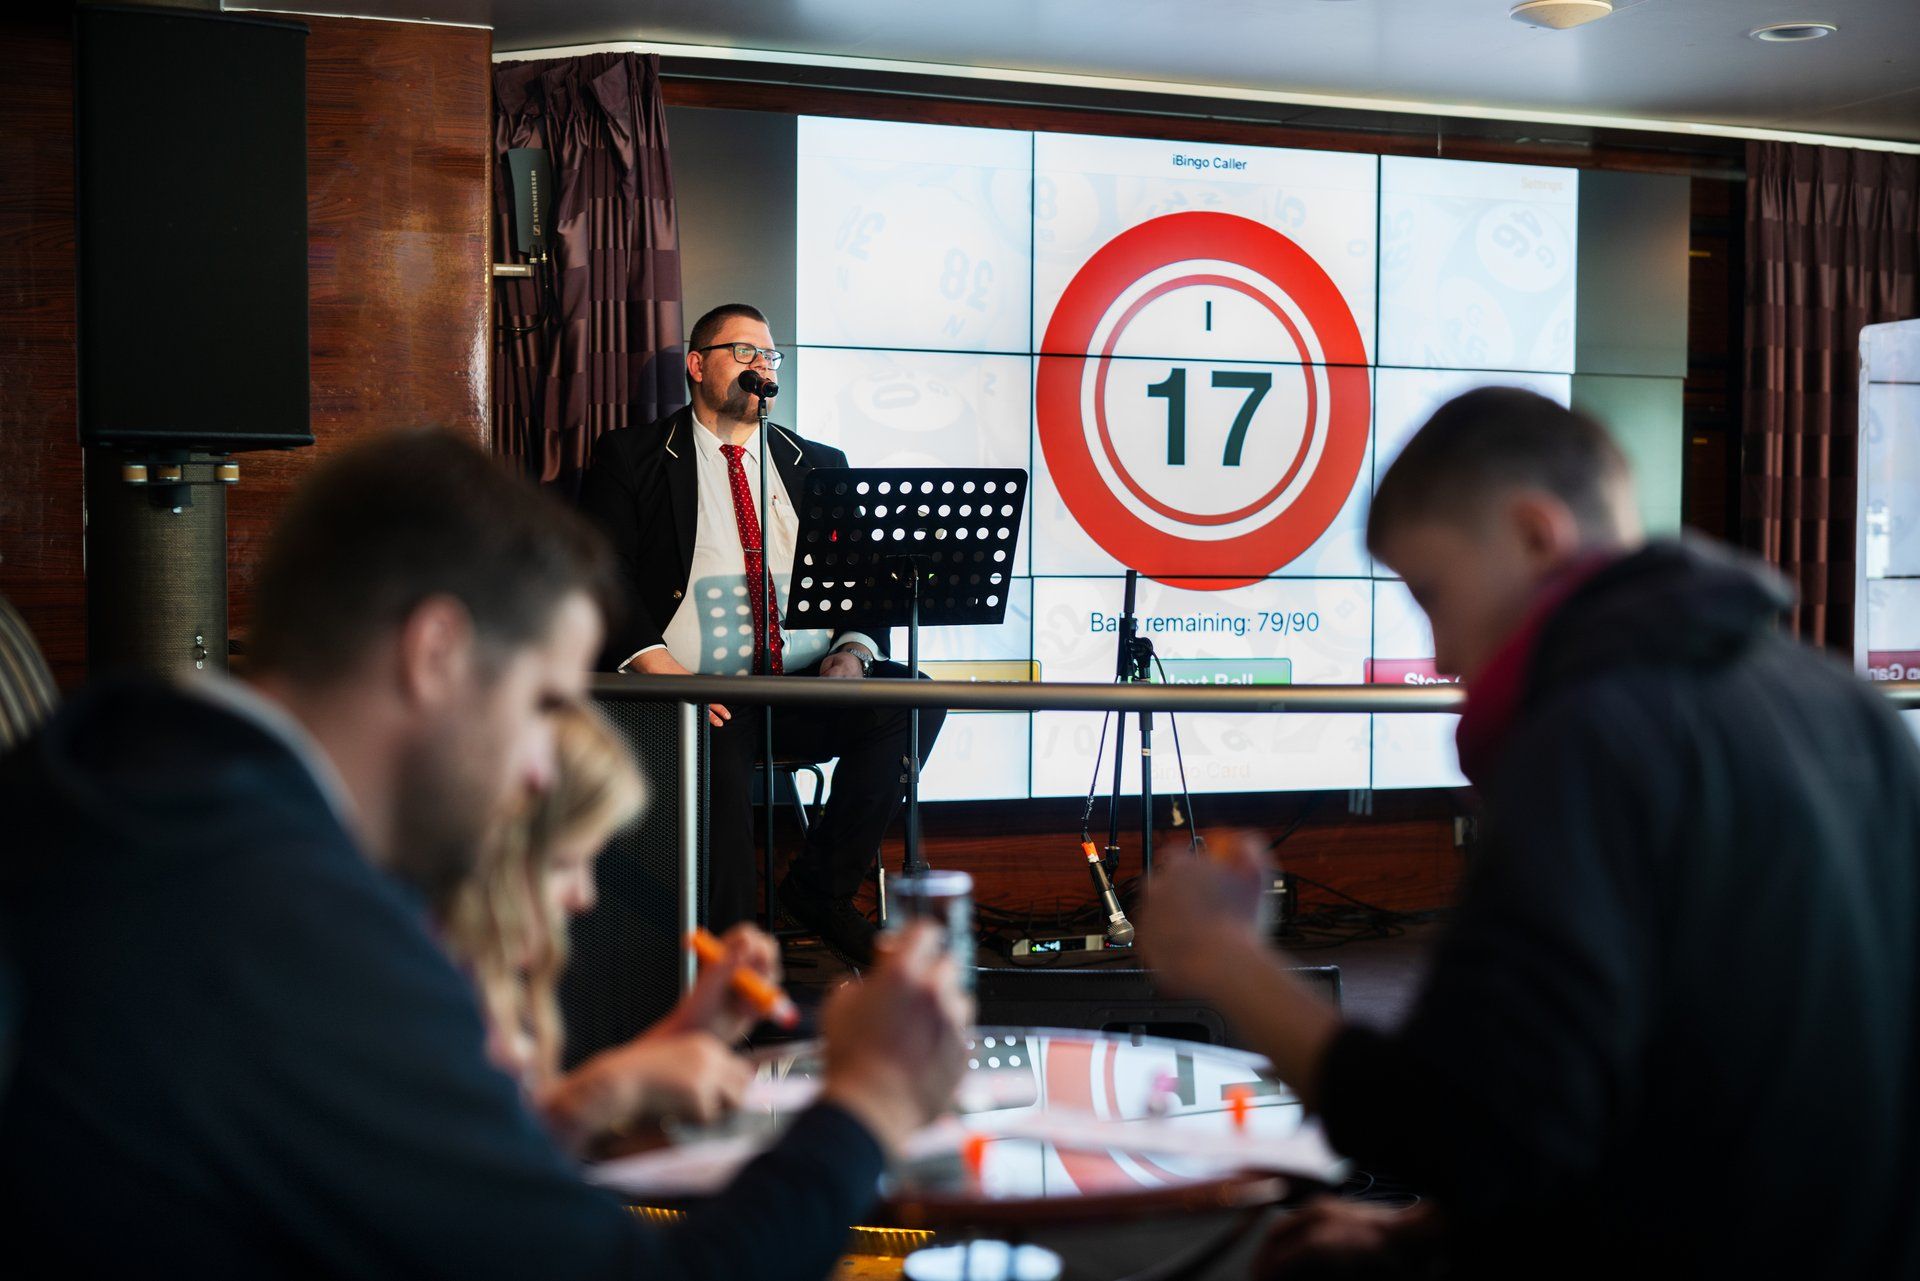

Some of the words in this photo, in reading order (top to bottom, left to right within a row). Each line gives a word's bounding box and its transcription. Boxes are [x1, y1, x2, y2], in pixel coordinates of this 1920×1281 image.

[1172, 154, 1210, 170] iBingo
[1213, 157, 1247, 170] Caller
[531, 169, 539, 224] SENNHEISER
[1147, 367, 1272, 467] 17
[1146, 612, 1250, 637] remaining:
[1258, 612, 1320, 636] 79/90
